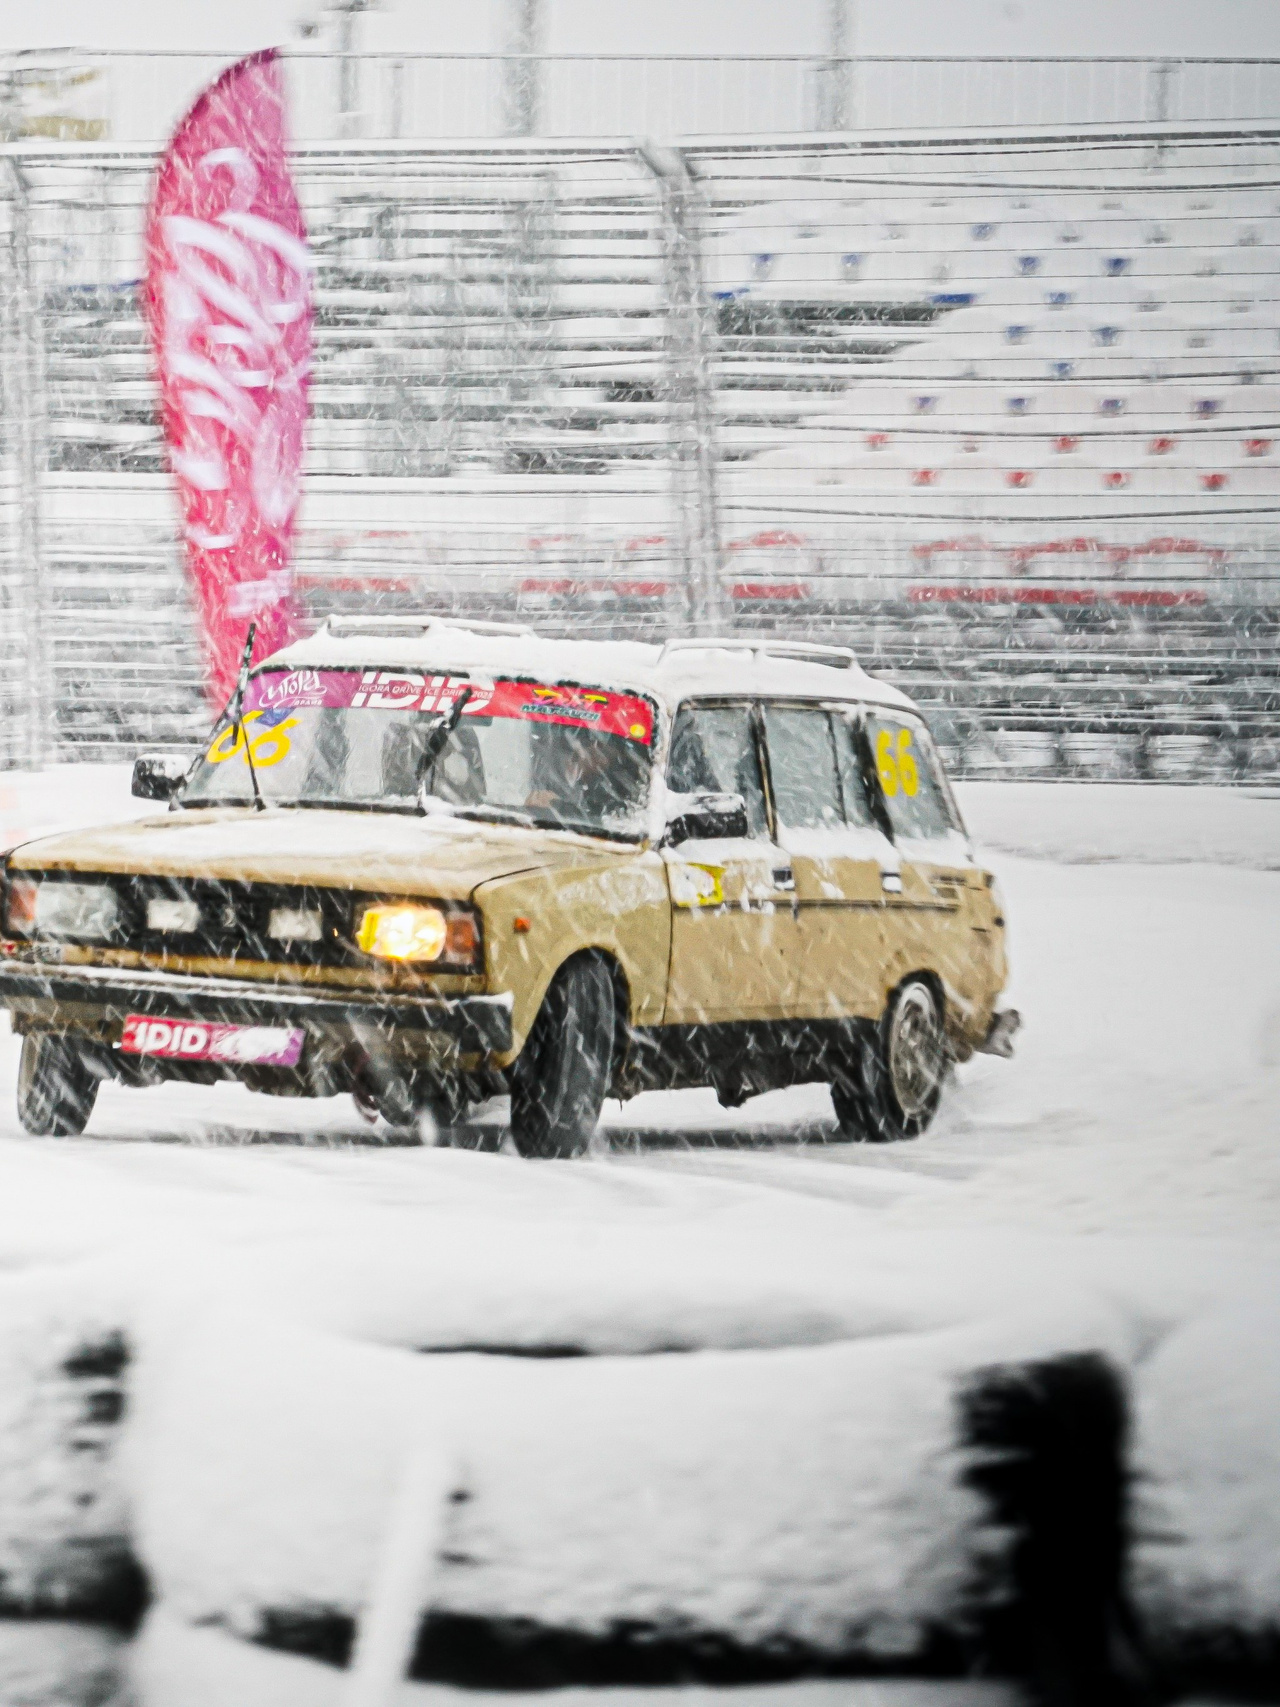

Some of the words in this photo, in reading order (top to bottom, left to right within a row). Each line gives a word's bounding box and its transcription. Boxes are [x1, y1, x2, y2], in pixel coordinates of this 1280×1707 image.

[351, 671, 495, 713] IDID
[358, 684, 390, 693] IGORA
[392, 684, 421, 694] DRIVE
[424, 687, 439, 696] ICE
[442, 688, 468, 698] DRIF
[206, 710, 302, 768] 66
[877, 728, 919, 798] 66
[134, 1022, 208, 1053] IDID
